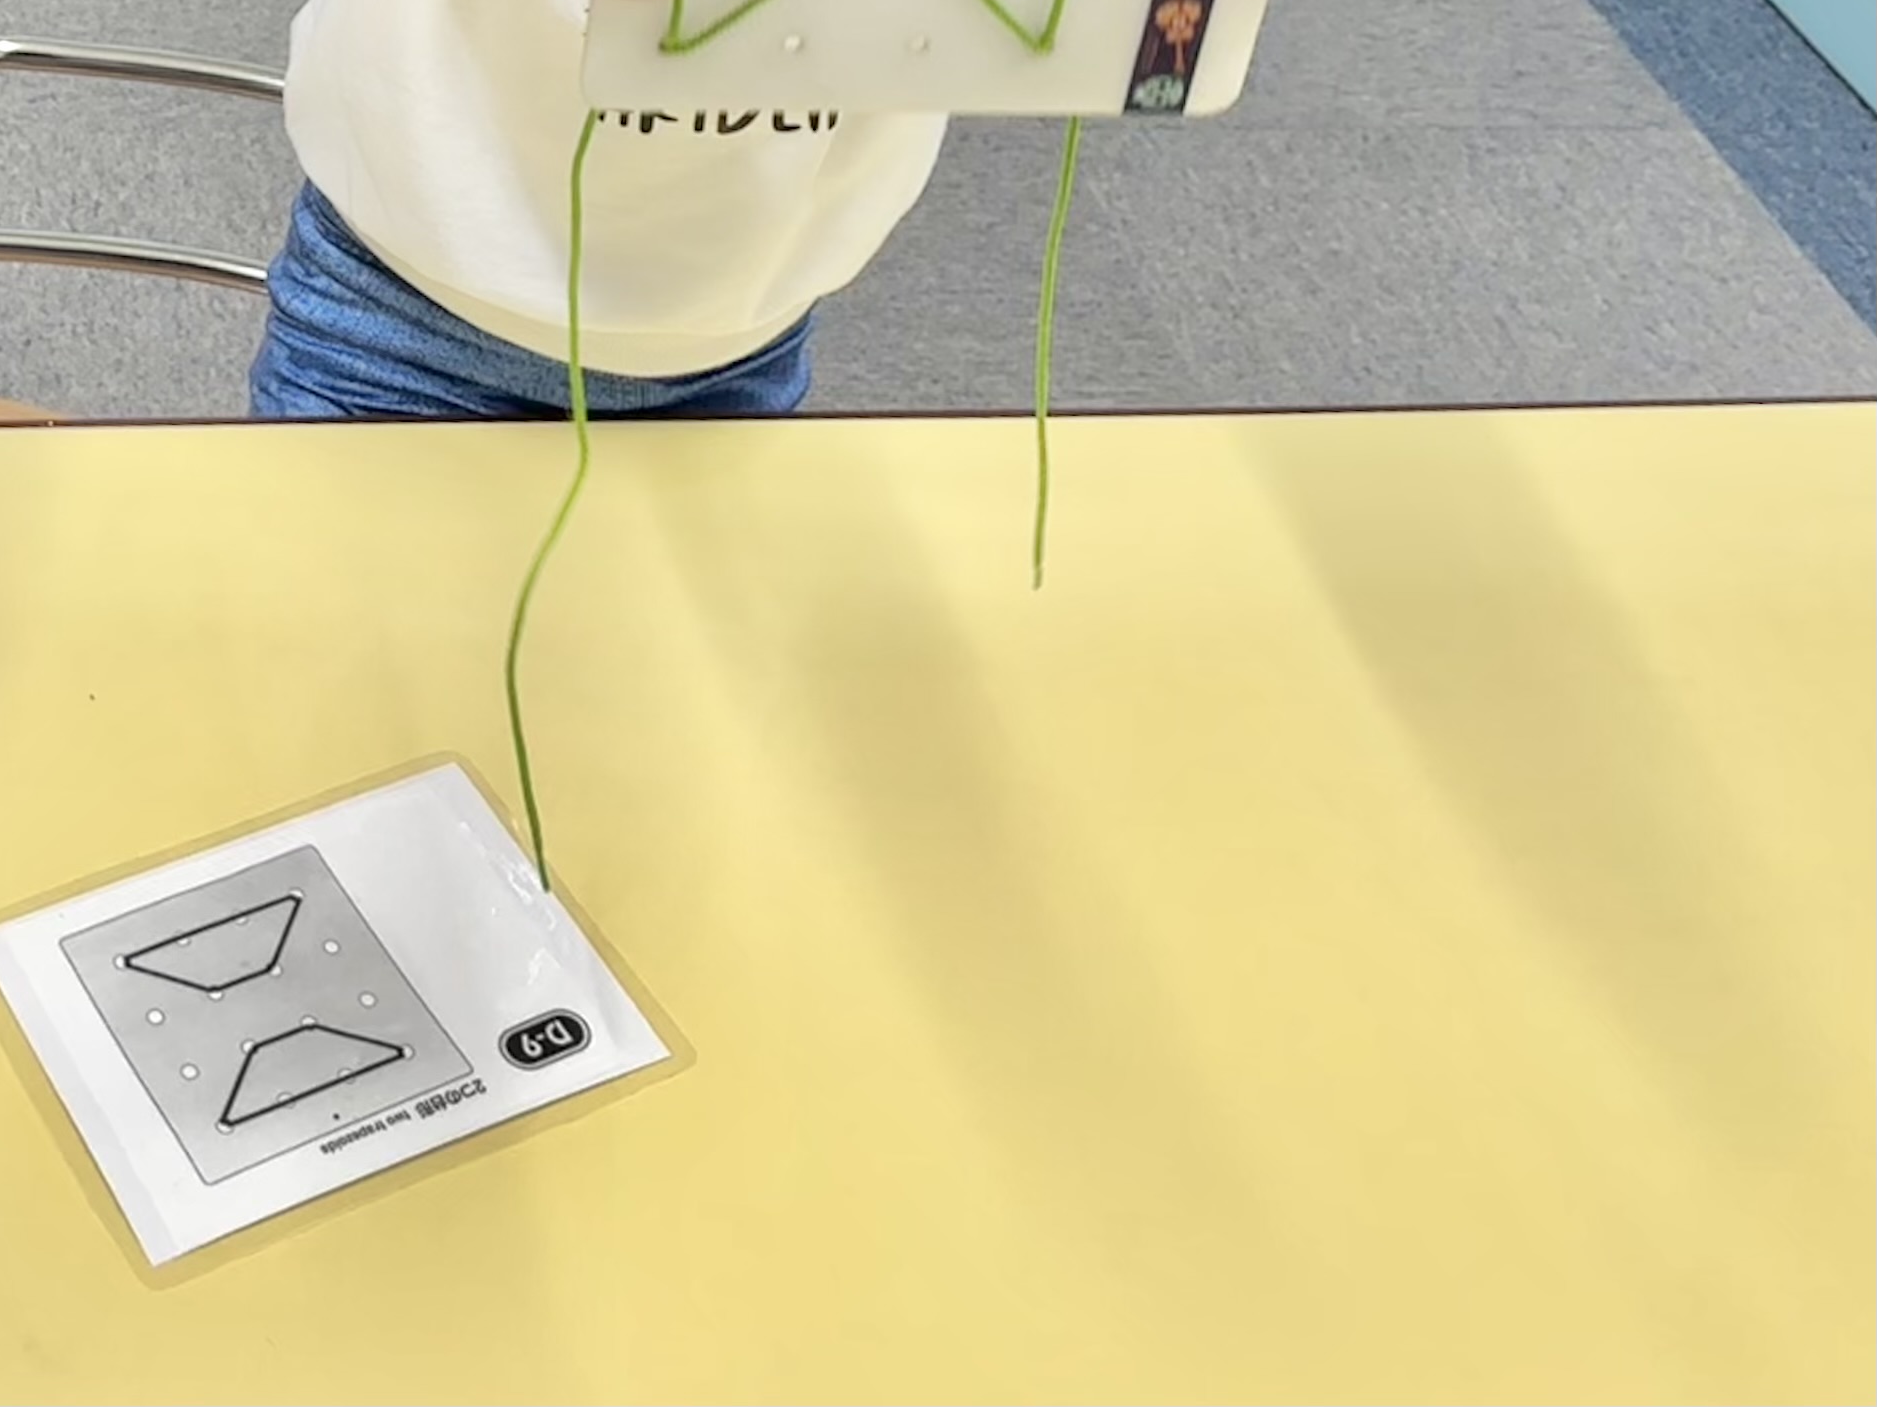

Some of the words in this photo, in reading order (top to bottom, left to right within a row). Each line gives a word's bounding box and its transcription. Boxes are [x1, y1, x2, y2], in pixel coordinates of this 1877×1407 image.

[519, 1018, 574, 1058] D-9
[386, 1108, 411, 1127] two
[414, 1078, 487, 1120] 2つの台形
[320, 1118, 387, 1156] trapezoids
